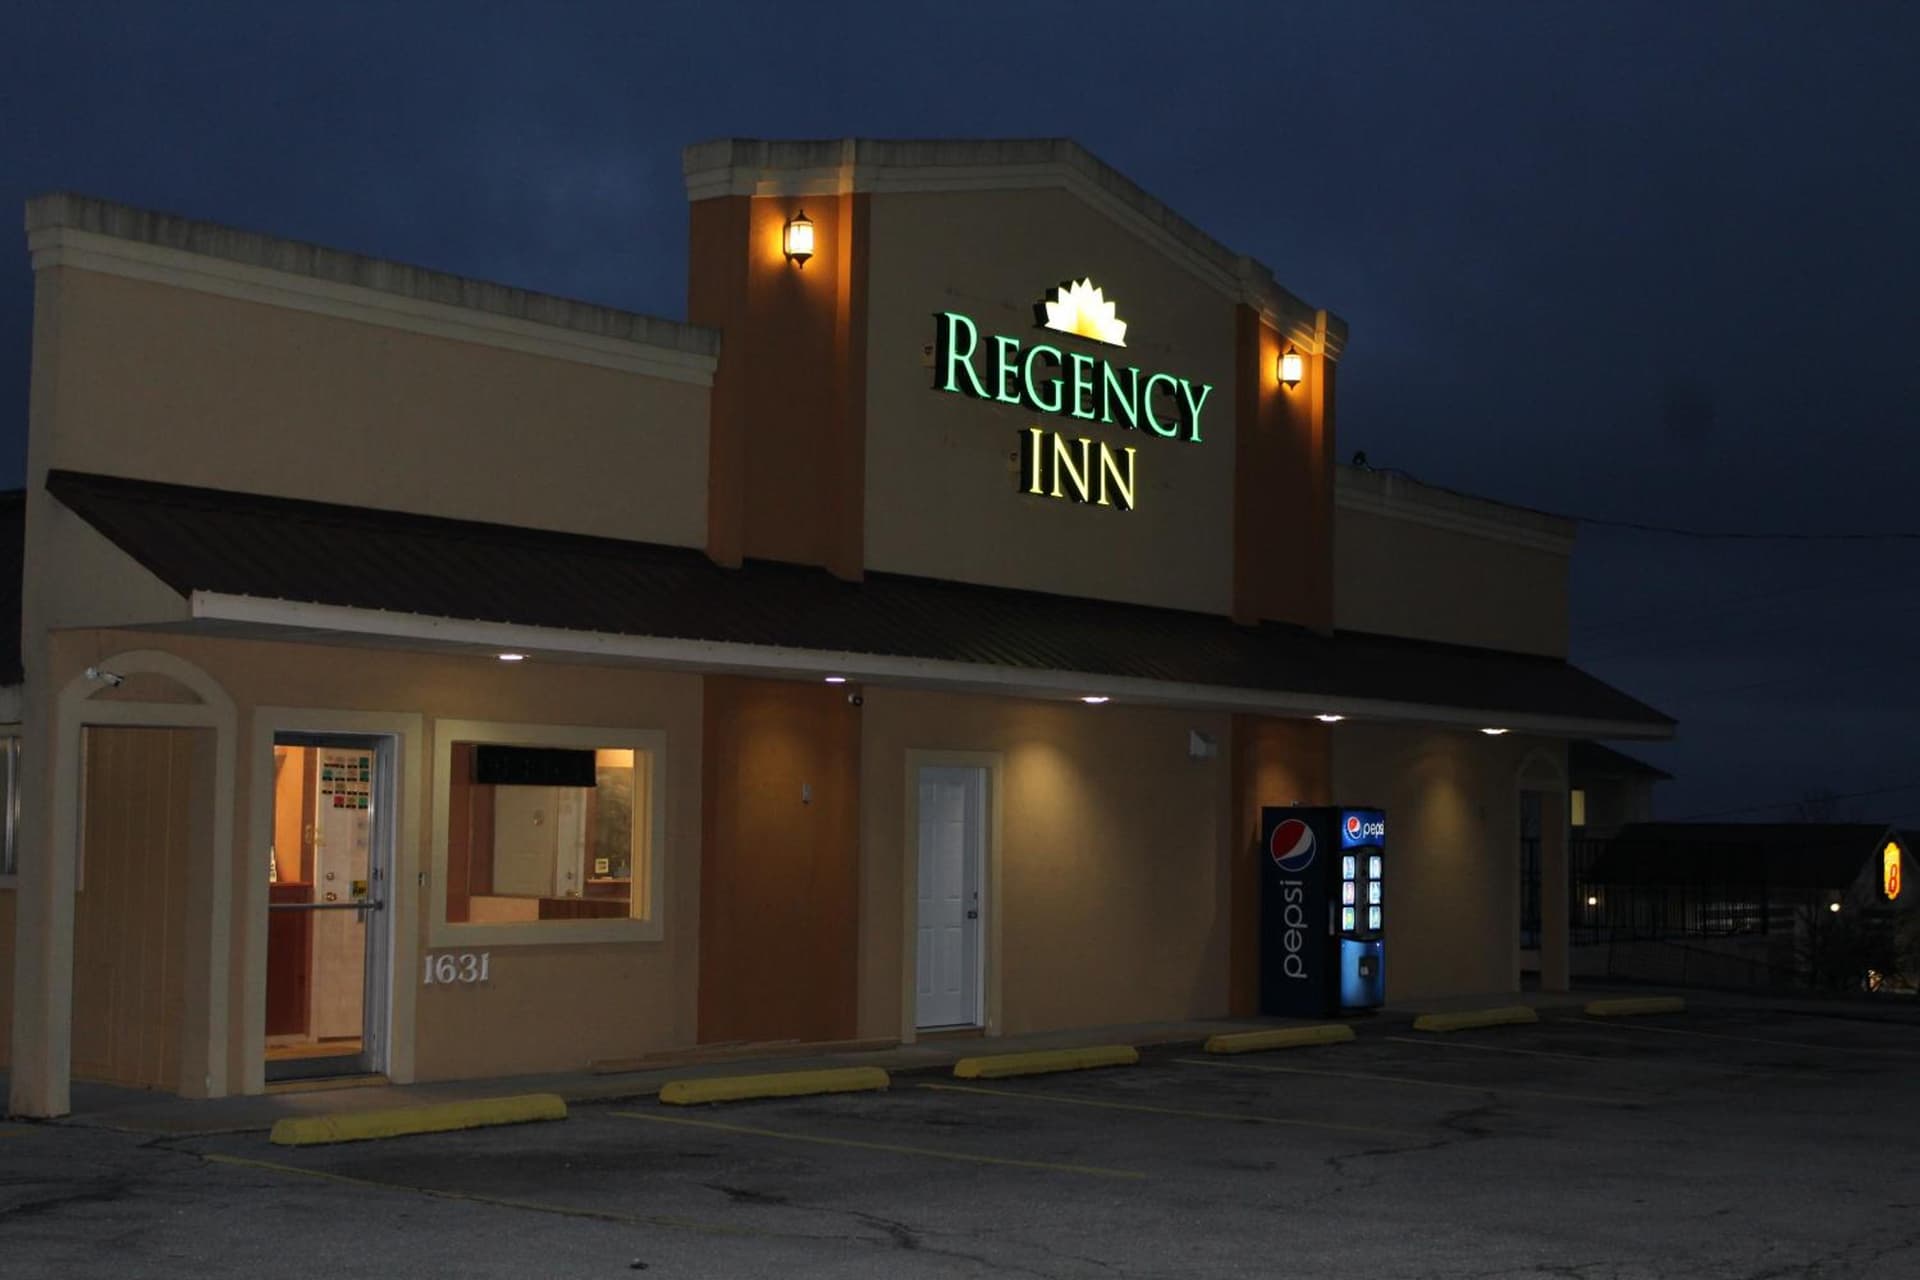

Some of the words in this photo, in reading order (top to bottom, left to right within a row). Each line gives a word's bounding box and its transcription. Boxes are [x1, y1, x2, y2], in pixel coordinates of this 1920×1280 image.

[943, 311, 1214, 443] REGENCY
[1029, 427, 1137, 512] INN
[423, 951, 490, 985] 1631
[1279, 879, 1310, 980] pepsi
